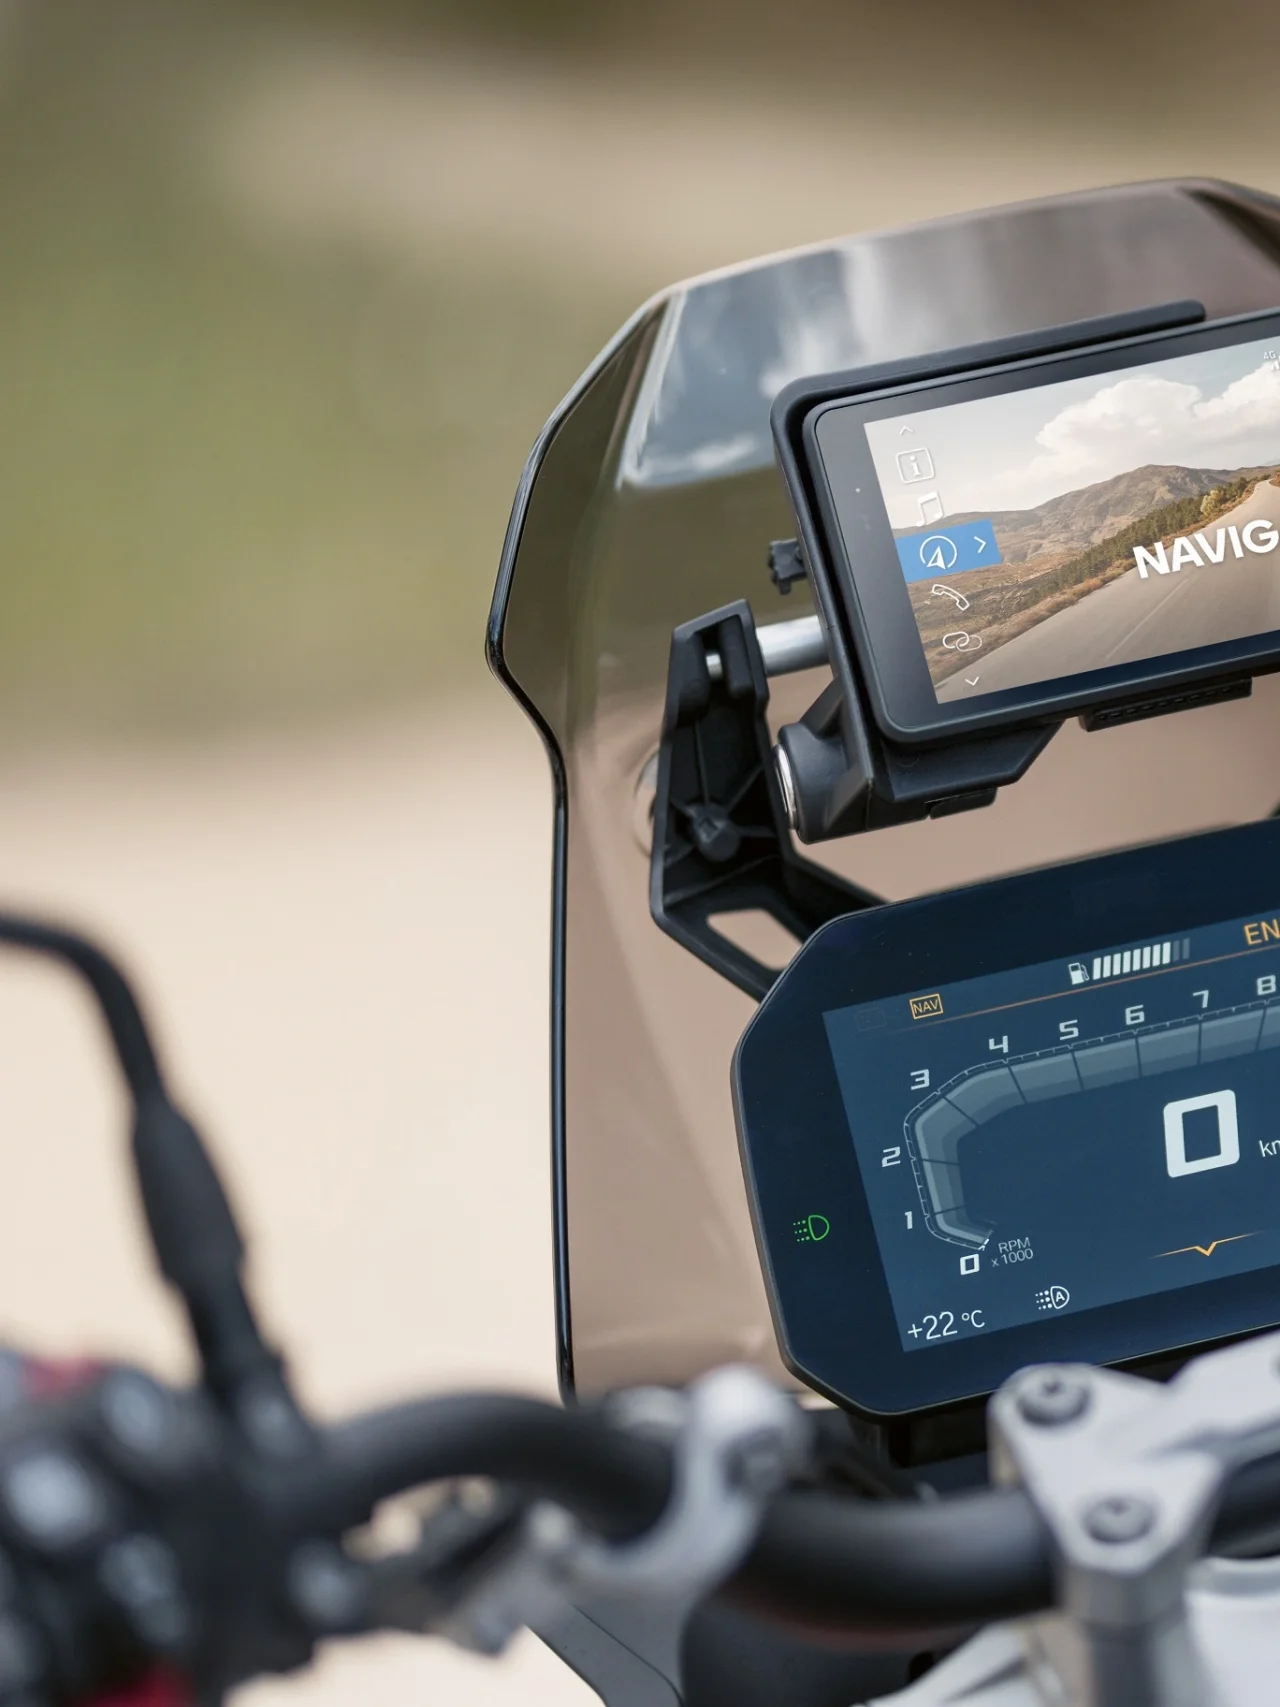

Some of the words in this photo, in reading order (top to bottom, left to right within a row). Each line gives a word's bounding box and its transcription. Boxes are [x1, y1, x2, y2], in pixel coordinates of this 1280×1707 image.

[1263, 350, 1276, 361] 4G
[1256, 975, 1277, 995] 8
[913, 999, 939, 1015] NAV
[1193, 989, 1209, 1009] 7
[1125, 1005, 1145, 1025] 6
[1059, 1019, 1079, 1040] 5
[988, 1035, 1009, 1054] 4
[910, 1068, 930, 1090] 3
[1162, 1088, 1241, 1178] 0
[881, 1146, 902, 1168] 2
[904, 1211, 913, 1230] 1
[998, 1237, 1031, 1253] RPM
[960, 1254, 980, 1276] 0
[907, 1311, 957, 1340] +22
[961, 1310, 986, 1329] °C
